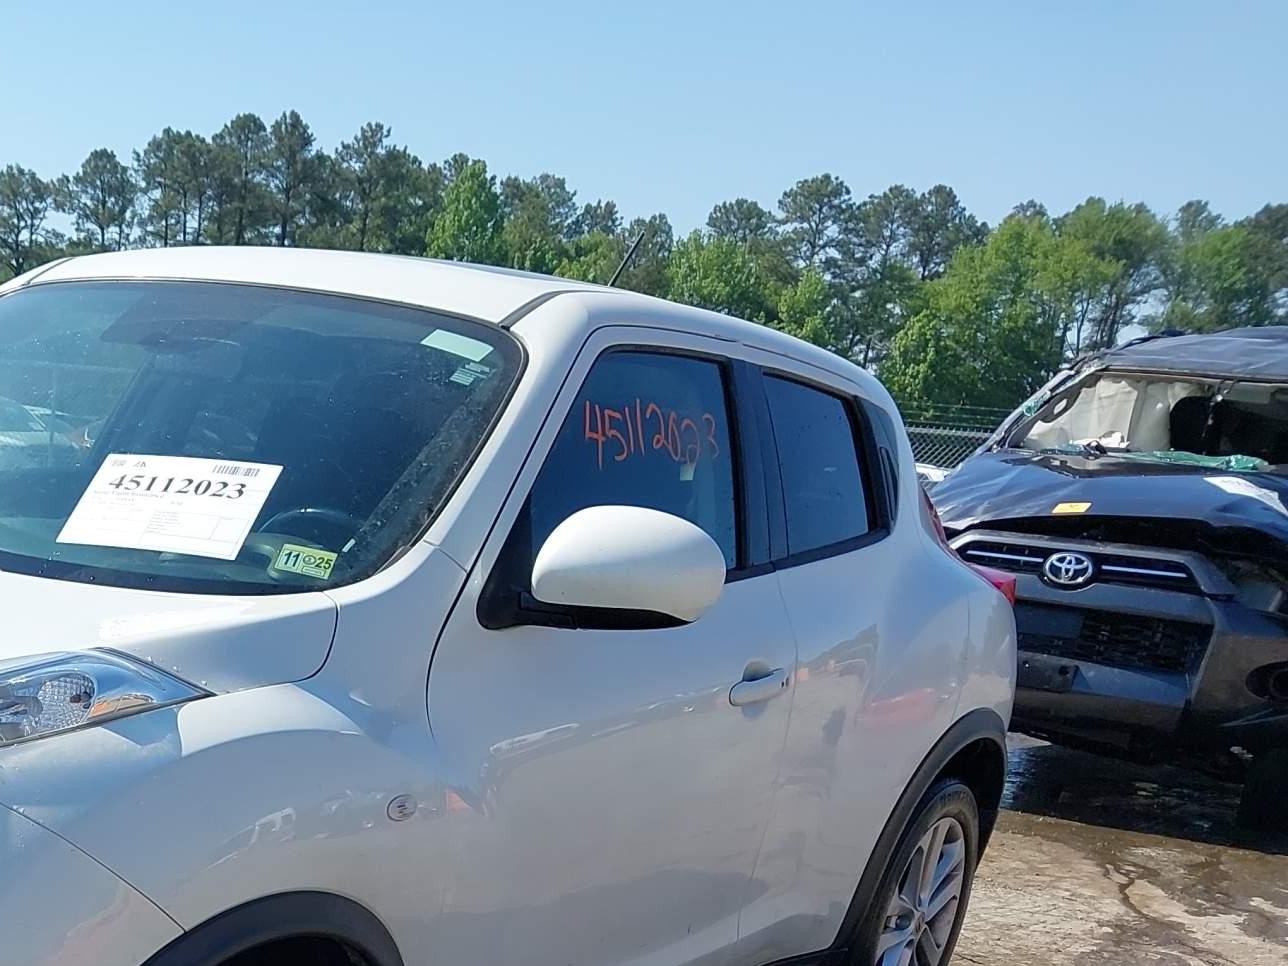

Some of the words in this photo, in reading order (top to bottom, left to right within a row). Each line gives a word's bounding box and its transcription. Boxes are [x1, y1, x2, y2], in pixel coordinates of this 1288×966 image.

[584, 398, 719, 470] 45112023
[108, 473, 247, 500] 45112023
[284, 551, 301, 568] 11
[315, 556, 333, 570] 25
